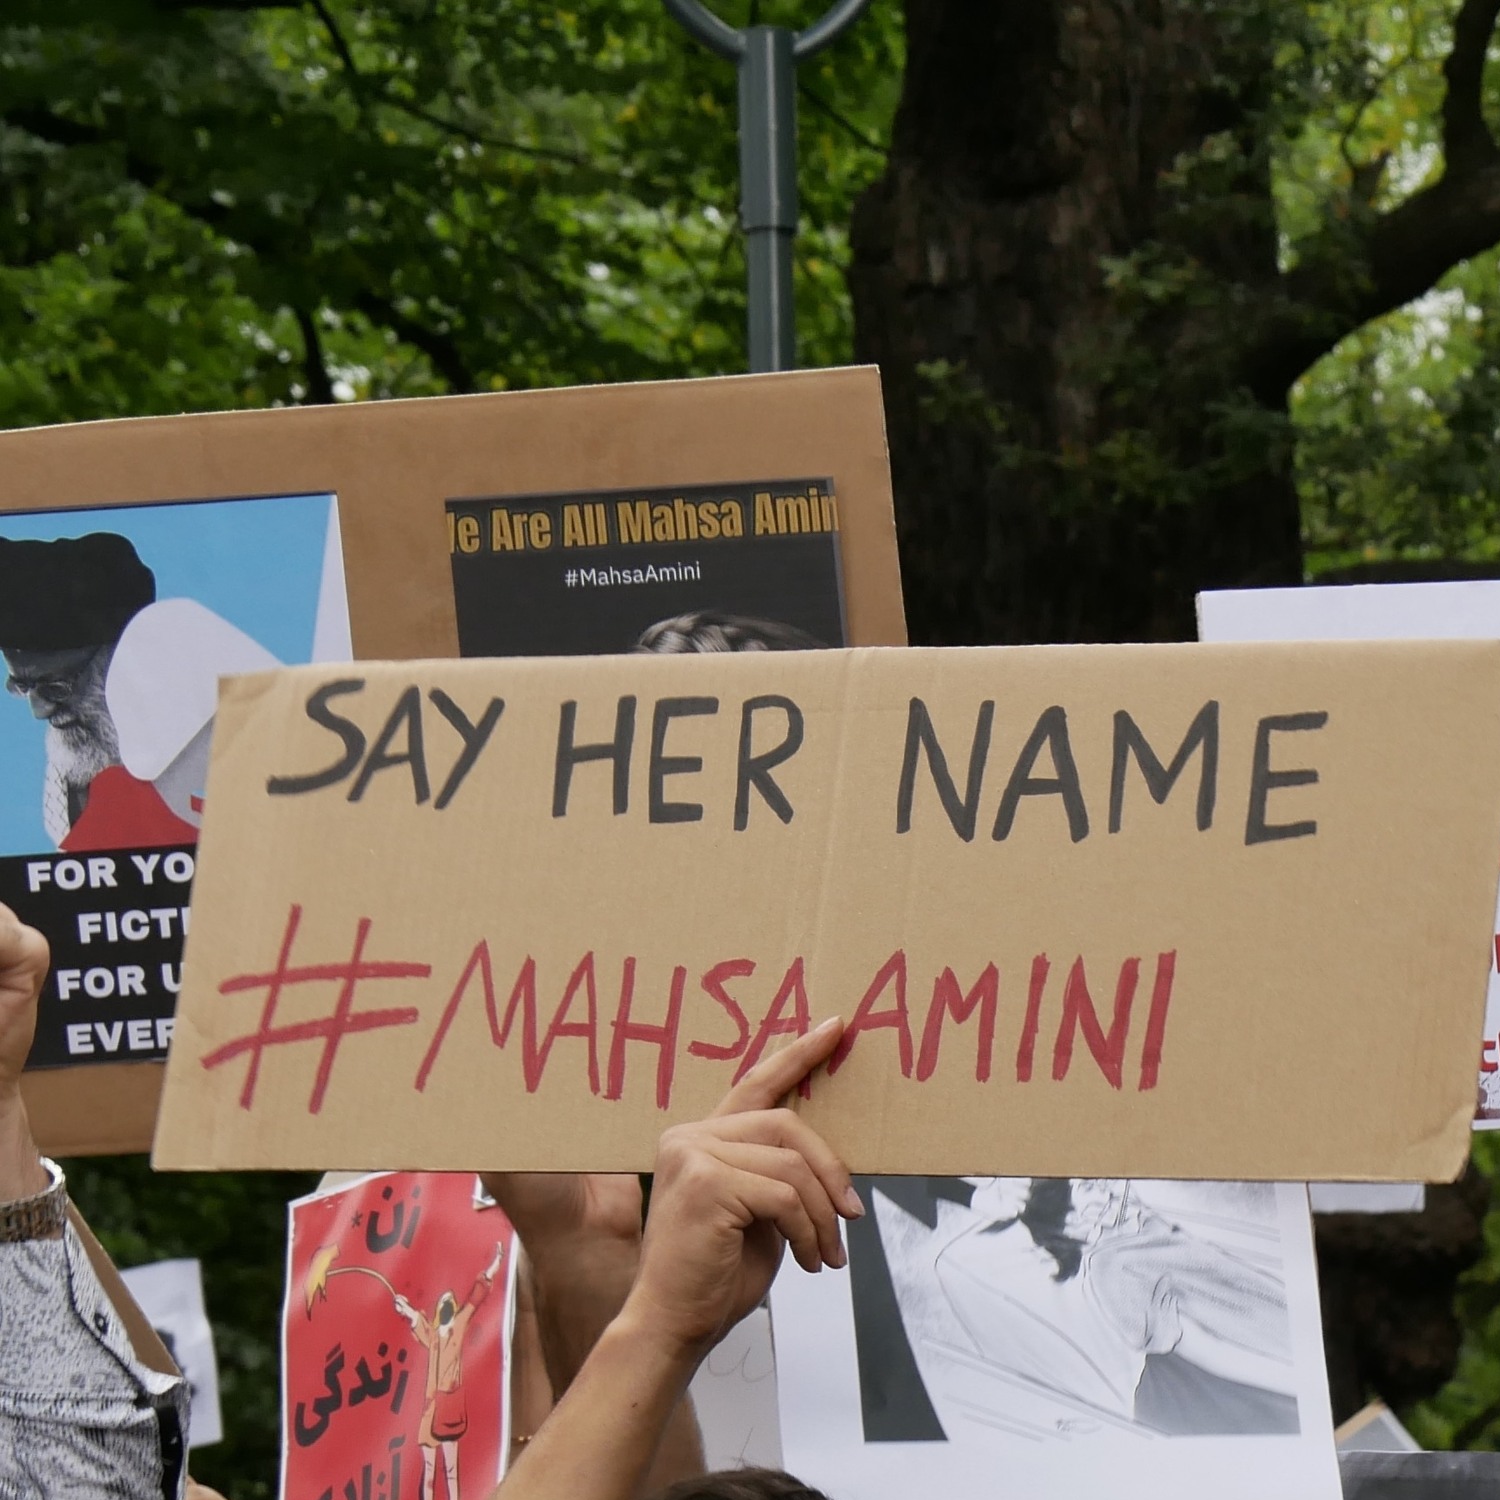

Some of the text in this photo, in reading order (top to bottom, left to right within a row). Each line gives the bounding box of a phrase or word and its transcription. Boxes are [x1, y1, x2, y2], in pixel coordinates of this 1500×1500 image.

[490, 508, 552, 553] Are
[563, 503, 608, 548] All
[616, 498, 744, 546] Mahsa
[753, 487, 839, 536] Amin
[564, 561, 701, 588] #MahsaAmini
[267, 678, 1329, 845] SAY HER NAME
[27, 852, 195, 893] FOR YO
[78, 906, 192, 944] FICTI
[57, 962, 186, 1000] FOR U
[67, 1017, 177, 1055] EVER
[294, 1342, 409, 1447] زندگی
